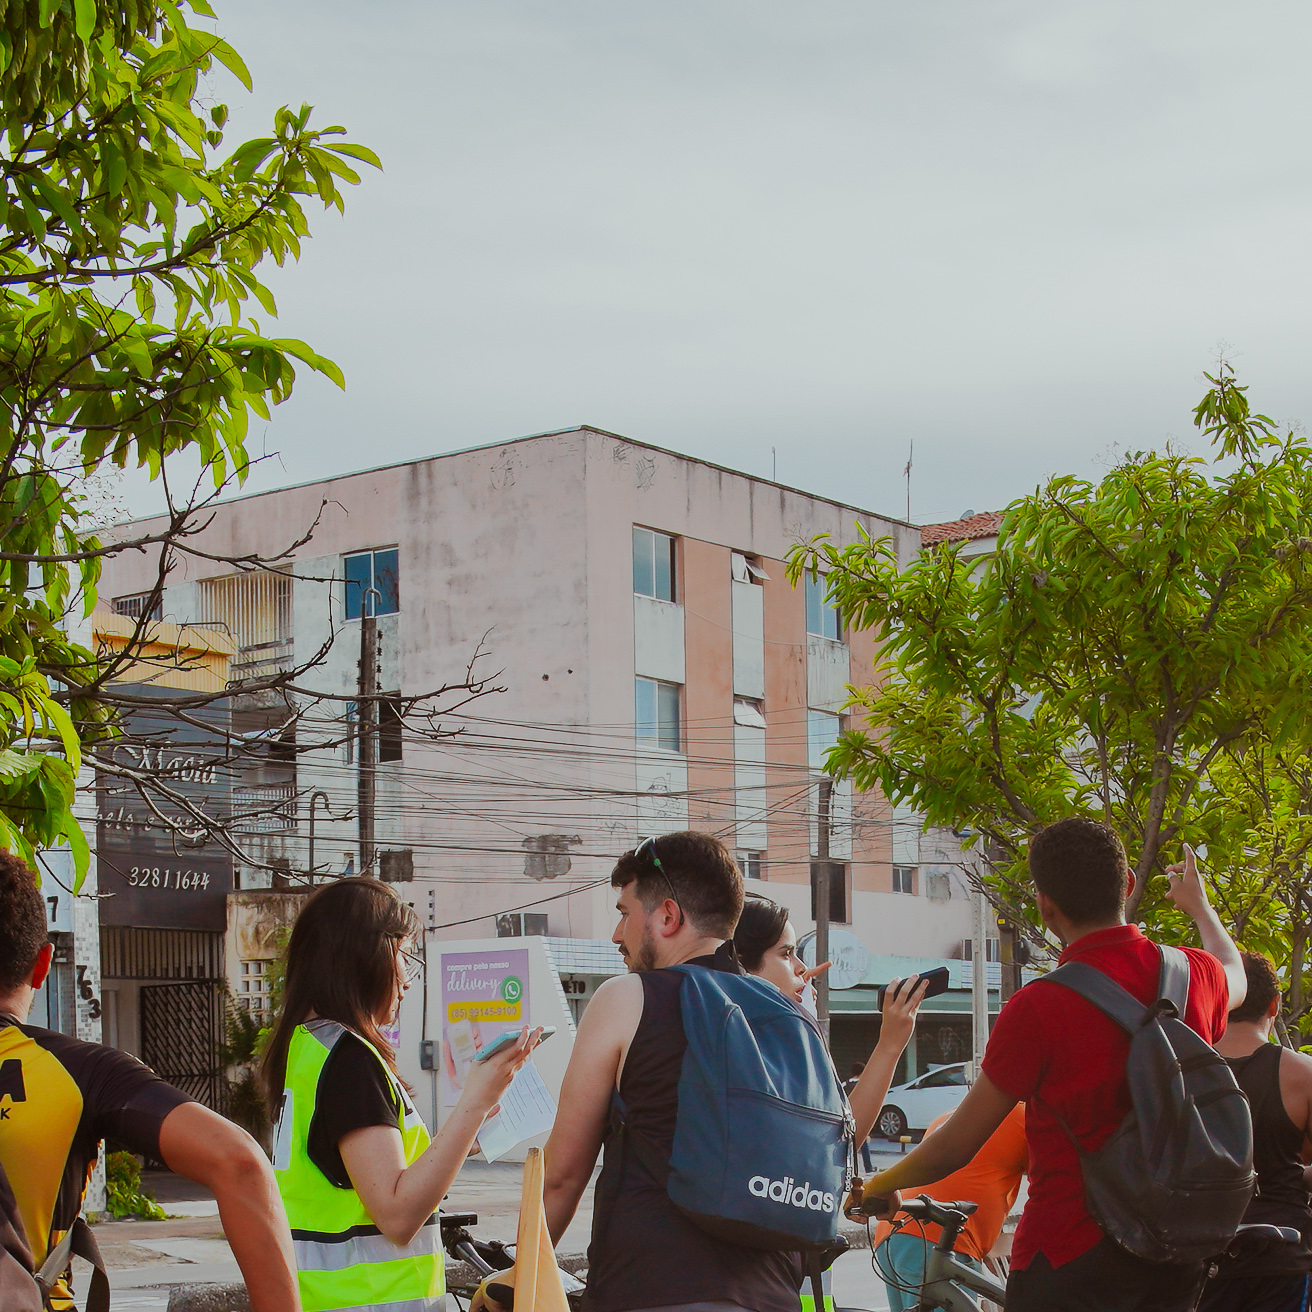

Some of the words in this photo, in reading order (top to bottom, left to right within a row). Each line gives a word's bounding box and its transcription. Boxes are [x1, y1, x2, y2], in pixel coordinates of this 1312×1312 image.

[446, 963, 472, 973] compre
[473, 962, 489, 972] pelo
[489, 961, 510, 970] nosso
[447, 971, 501, 999] delivery
[748, 1175, 834, 1213] adidas
